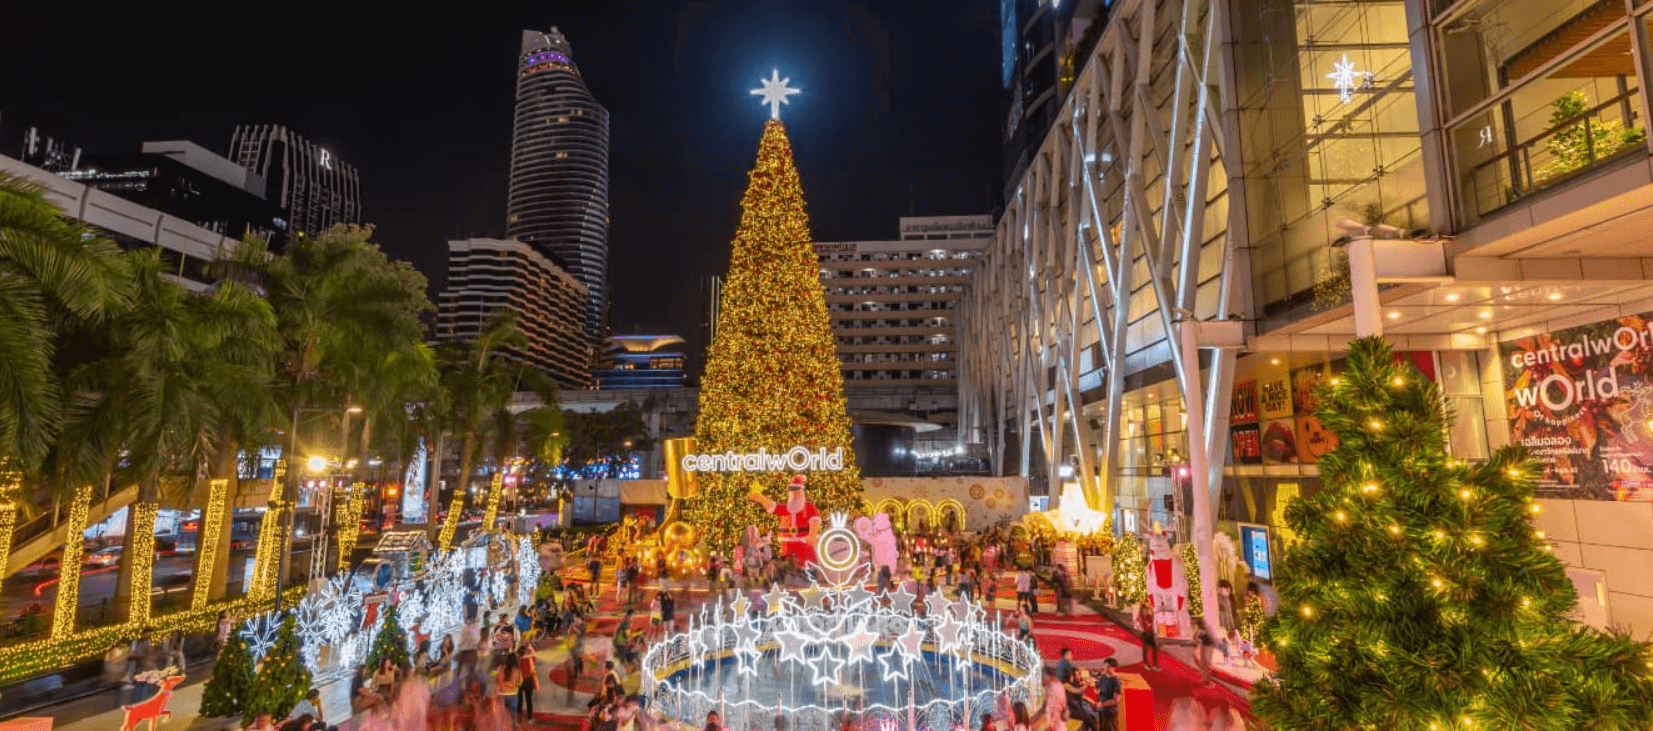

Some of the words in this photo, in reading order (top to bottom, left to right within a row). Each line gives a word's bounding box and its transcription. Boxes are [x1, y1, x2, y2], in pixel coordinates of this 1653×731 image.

[319, 147, 332, 170] R
[1515, 366, 1619, 411] wOrld
[682, 445, 843, 472] centralwOrld
[1602, 459, 1631, 474] 140
